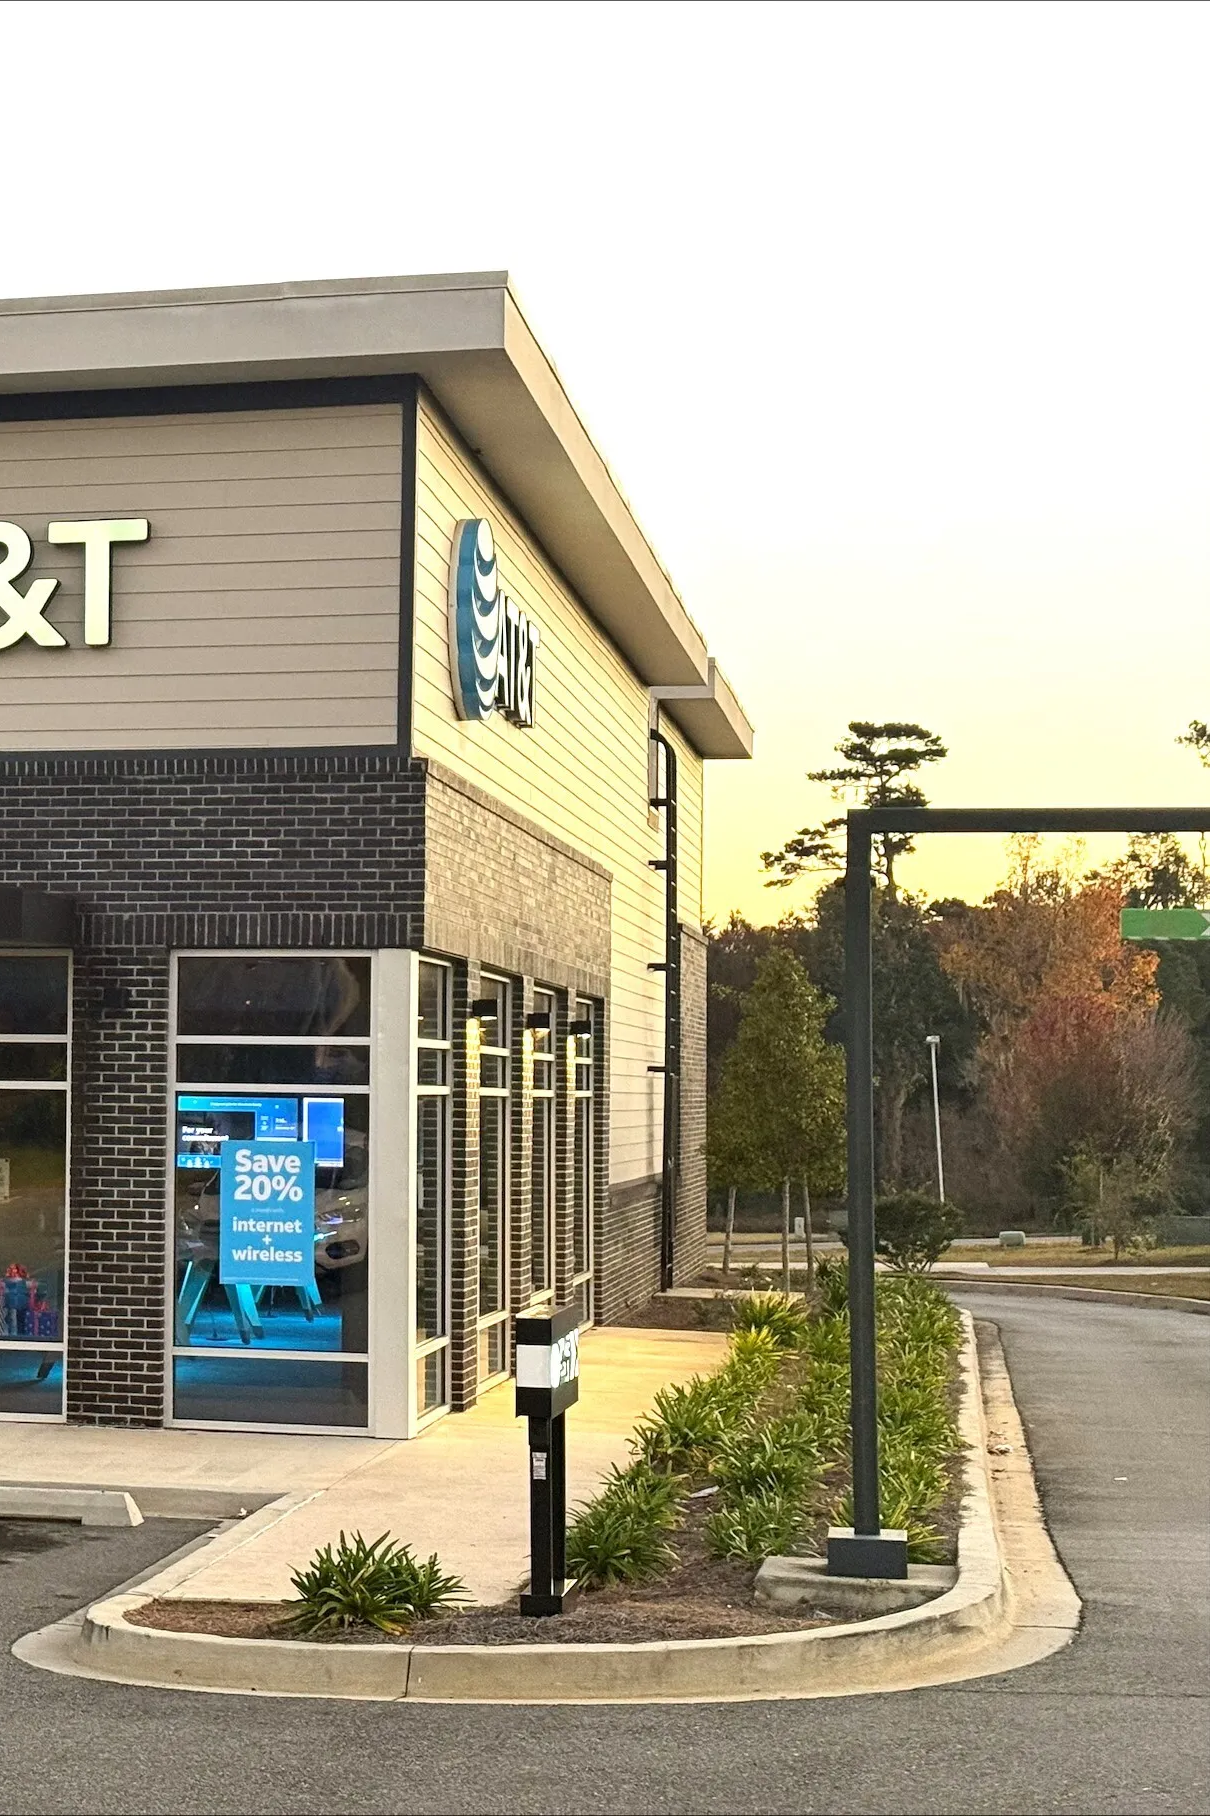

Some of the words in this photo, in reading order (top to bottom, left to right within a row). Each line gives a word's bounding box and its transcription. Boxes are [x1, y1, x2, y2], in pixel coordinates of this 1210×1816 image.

[496, 589, 540, 729] AT&T
[235, 1149, 301, 1174] Save
[233, 1174, 303, 1202] 20%
[232, 1216, 303, 1234] internet
[232, 1246, 303, 1263] wireless
